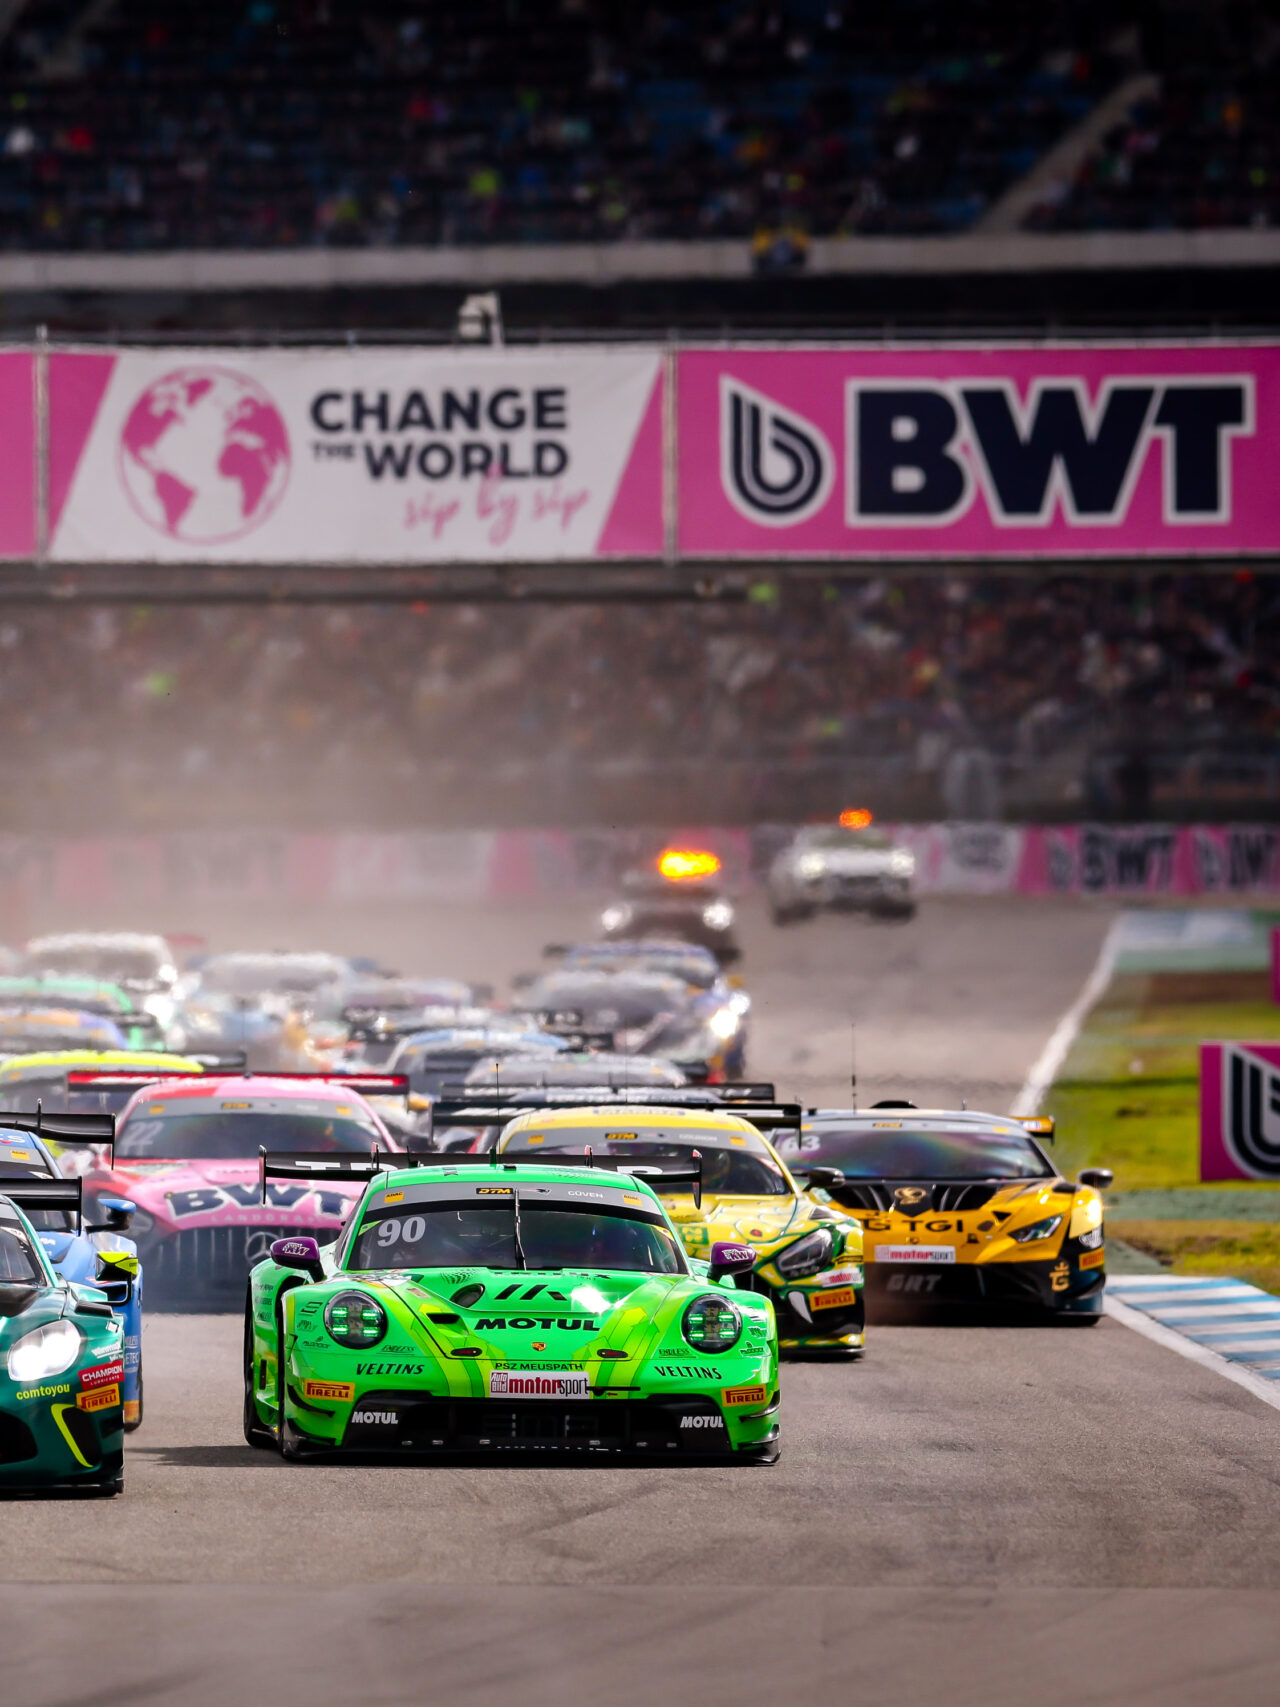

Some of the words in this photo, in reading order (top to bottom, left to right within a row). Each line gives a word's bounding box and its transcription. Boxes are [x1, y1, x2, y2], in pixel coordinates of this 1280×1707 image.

[310, 386, 568, 433] CHANGE
[311, 441, 355, 461] THE
[364, 440, 568, 480] WORLD
[845, 376, 1255, 528] BWT
[404, 490, 460, 540] sip
[476, 463, 518, 546] by
[532, 481, 591, 532] sip
[167, 1181, 354, 1220] BWT
[567, 1189, 604, 1198] GÜVEN
[377, 1216, 426, 1247] 90
[901, 1219, 964, 1232] TGI
[474, 1317, 601, 1332] MOTUL
[659, 1347, 691, 1355] ENDLESS
[81, 1364, 122, 1382] CHAMPION
[356, 1363, 425, 1375] VELTINS
[495, 1362, 517, 1370] PSZ
[654, 1365, 723, 1380] VELTINS
[16, 1384, 70, 1400] comtoyou
[81, 1389, 116, 1408] PIRELLI
[306, 1382, 350, 1399] PIRELLI
[725, 1388, 764, 1404] PIRELLI
[351, 1411, 399, 1424] MOTUL
[680, 1415, 724, 1429] MOTUL
